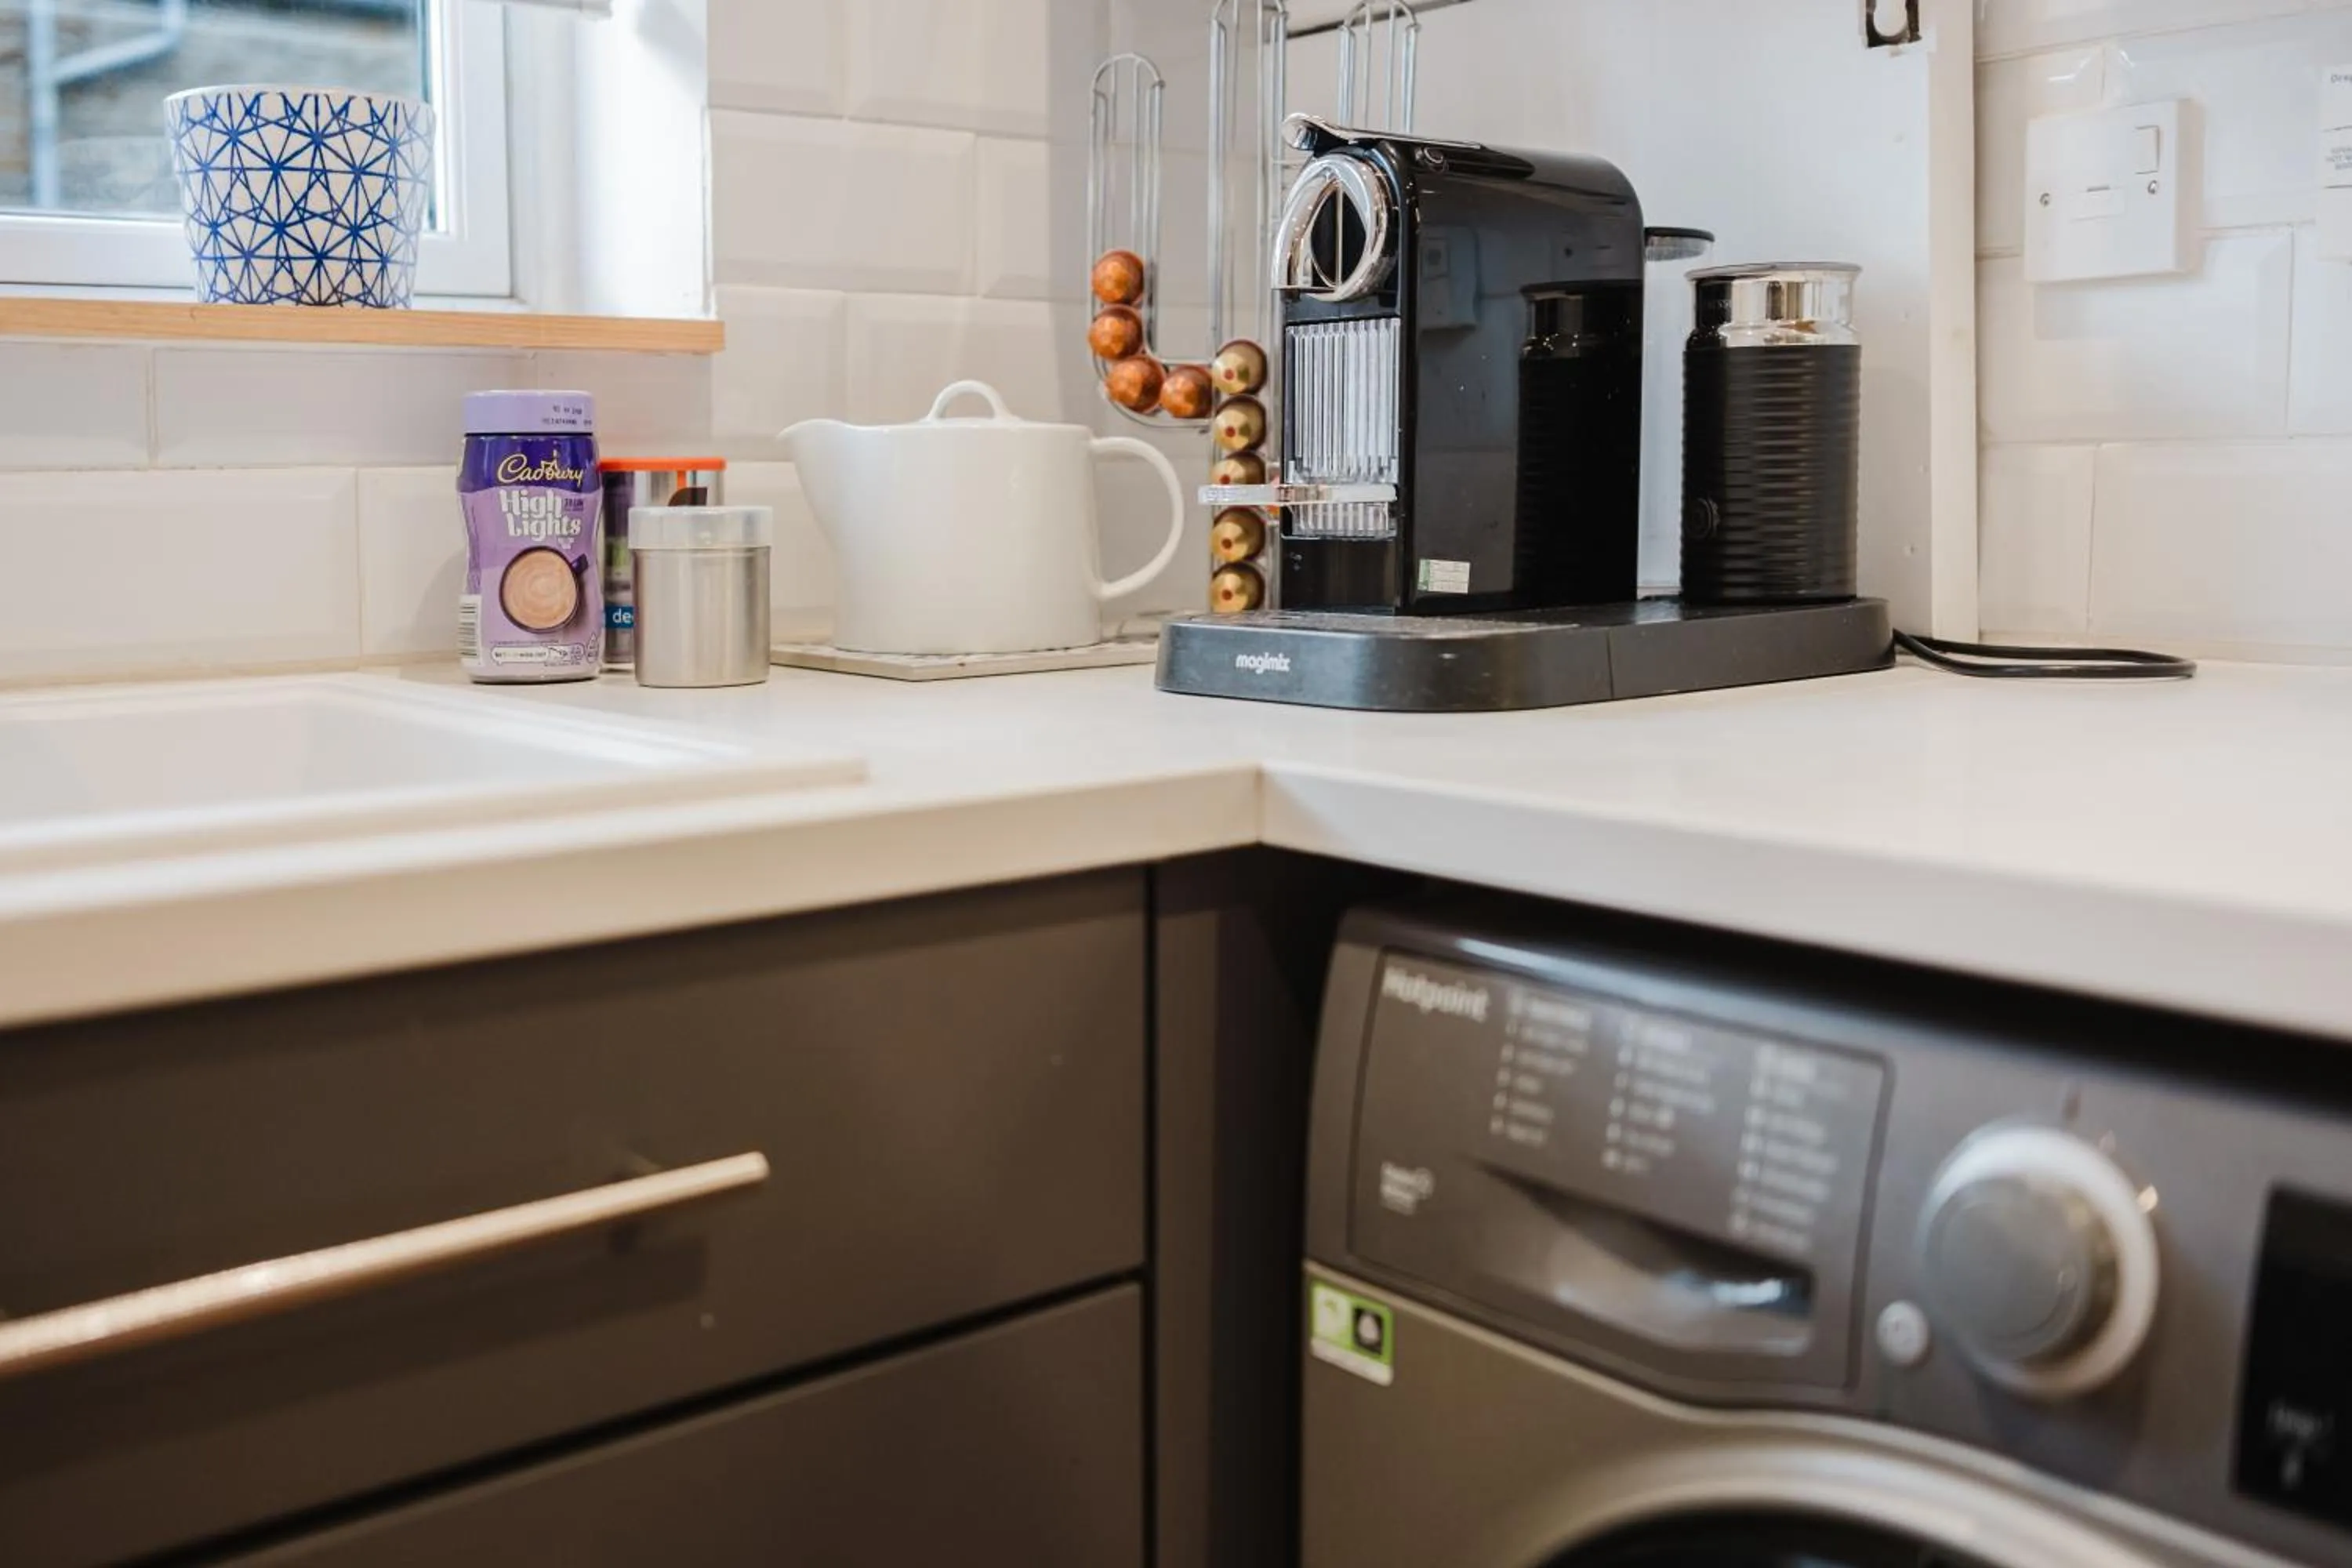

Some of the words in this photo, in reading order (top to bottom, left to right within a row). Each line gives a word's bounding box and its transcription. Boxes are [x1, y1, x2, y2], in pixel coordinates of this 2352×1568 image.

[498, 451, 583, 488] Cadbury
[499, 489, 563, 519] High
[506, 513, 581, 542] Lights
[612, 608, 633, 624] de
[1382, 967, 1490, 1022] Hotpoint
